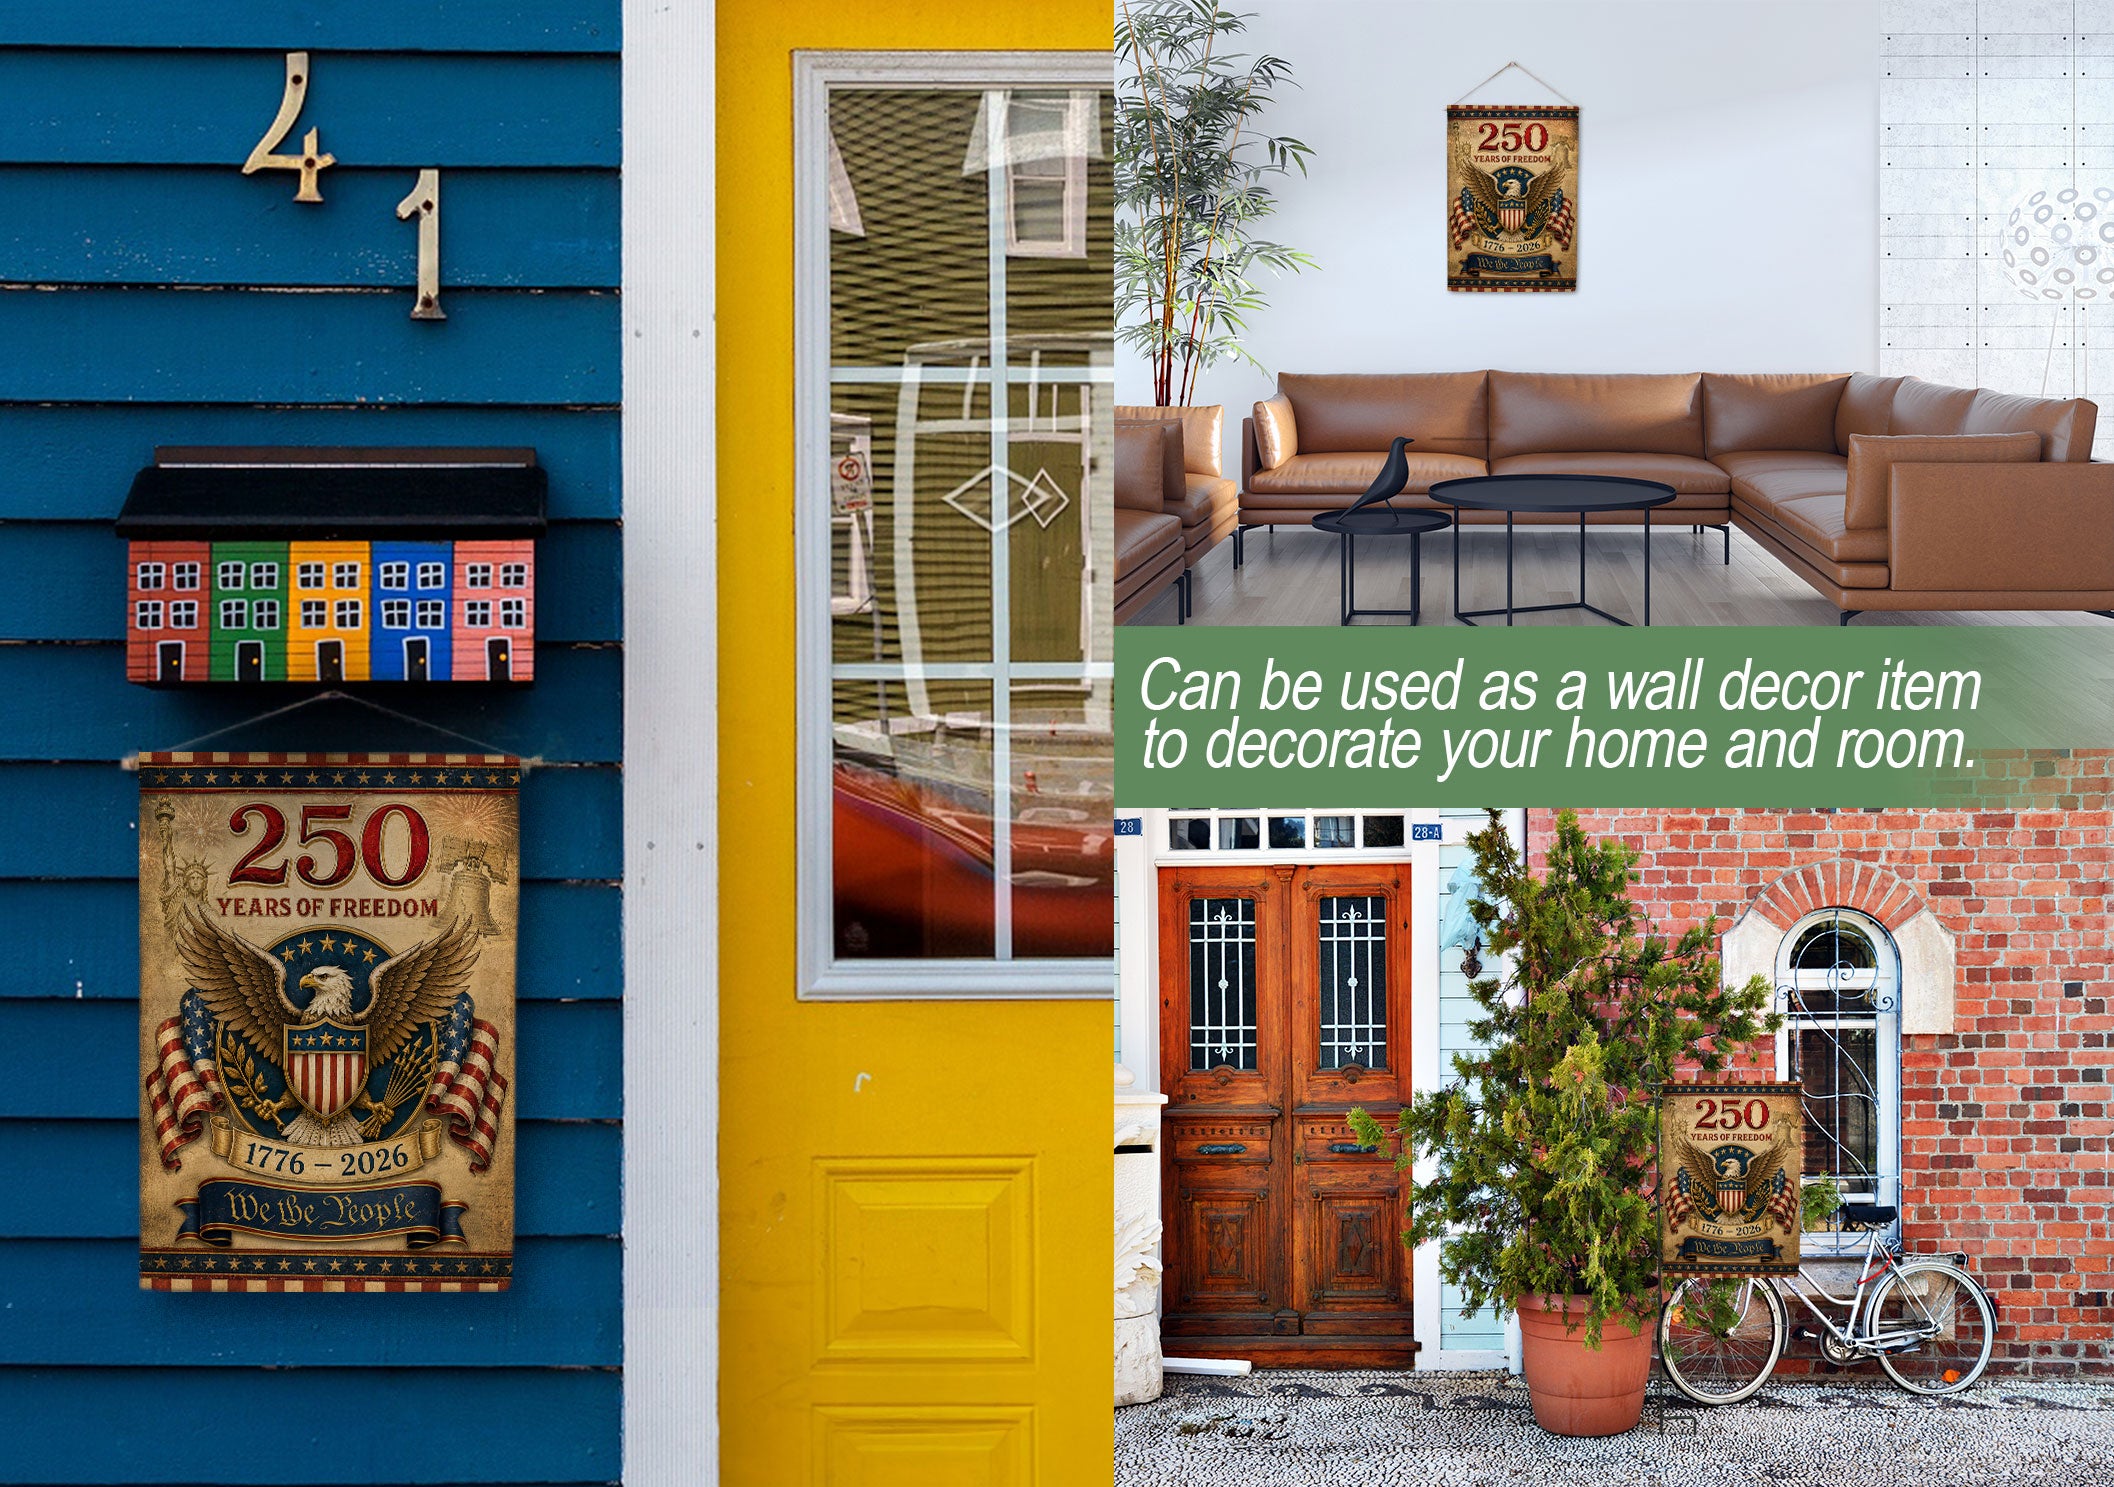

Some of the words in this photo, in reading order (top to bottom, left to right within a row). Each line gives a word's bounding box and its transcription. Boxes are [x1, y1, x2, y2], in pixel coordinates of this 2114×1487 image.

[1478, 123, 1548, 151] 250
[1484, 241, 1504, 251] 1776
[1517, 242, 1540, 252] 2026
[1120, 821, 1134, 833] 28
[1414, 826, 1440, 839] 28-A
[227, 803, 432, 889] 250
[218, 898, 292, 917] YEARS
[296, 898, 326, 917] OF
[330, 898, 438, 917] FREEDOM
[1695, 1099, 1769, 1129] 250
[245, 1143, 304, 1175] 1776
[341, 1145, 408, 1177] 2026
[224, 1188, 275, 1224] We
[277, 1186, 315, 1227] the
[320, 1191, 421, 1228] People
[1702, 1223, 1723, 1235] 1776
[1736, 1224, 1761, 1235] 2026
